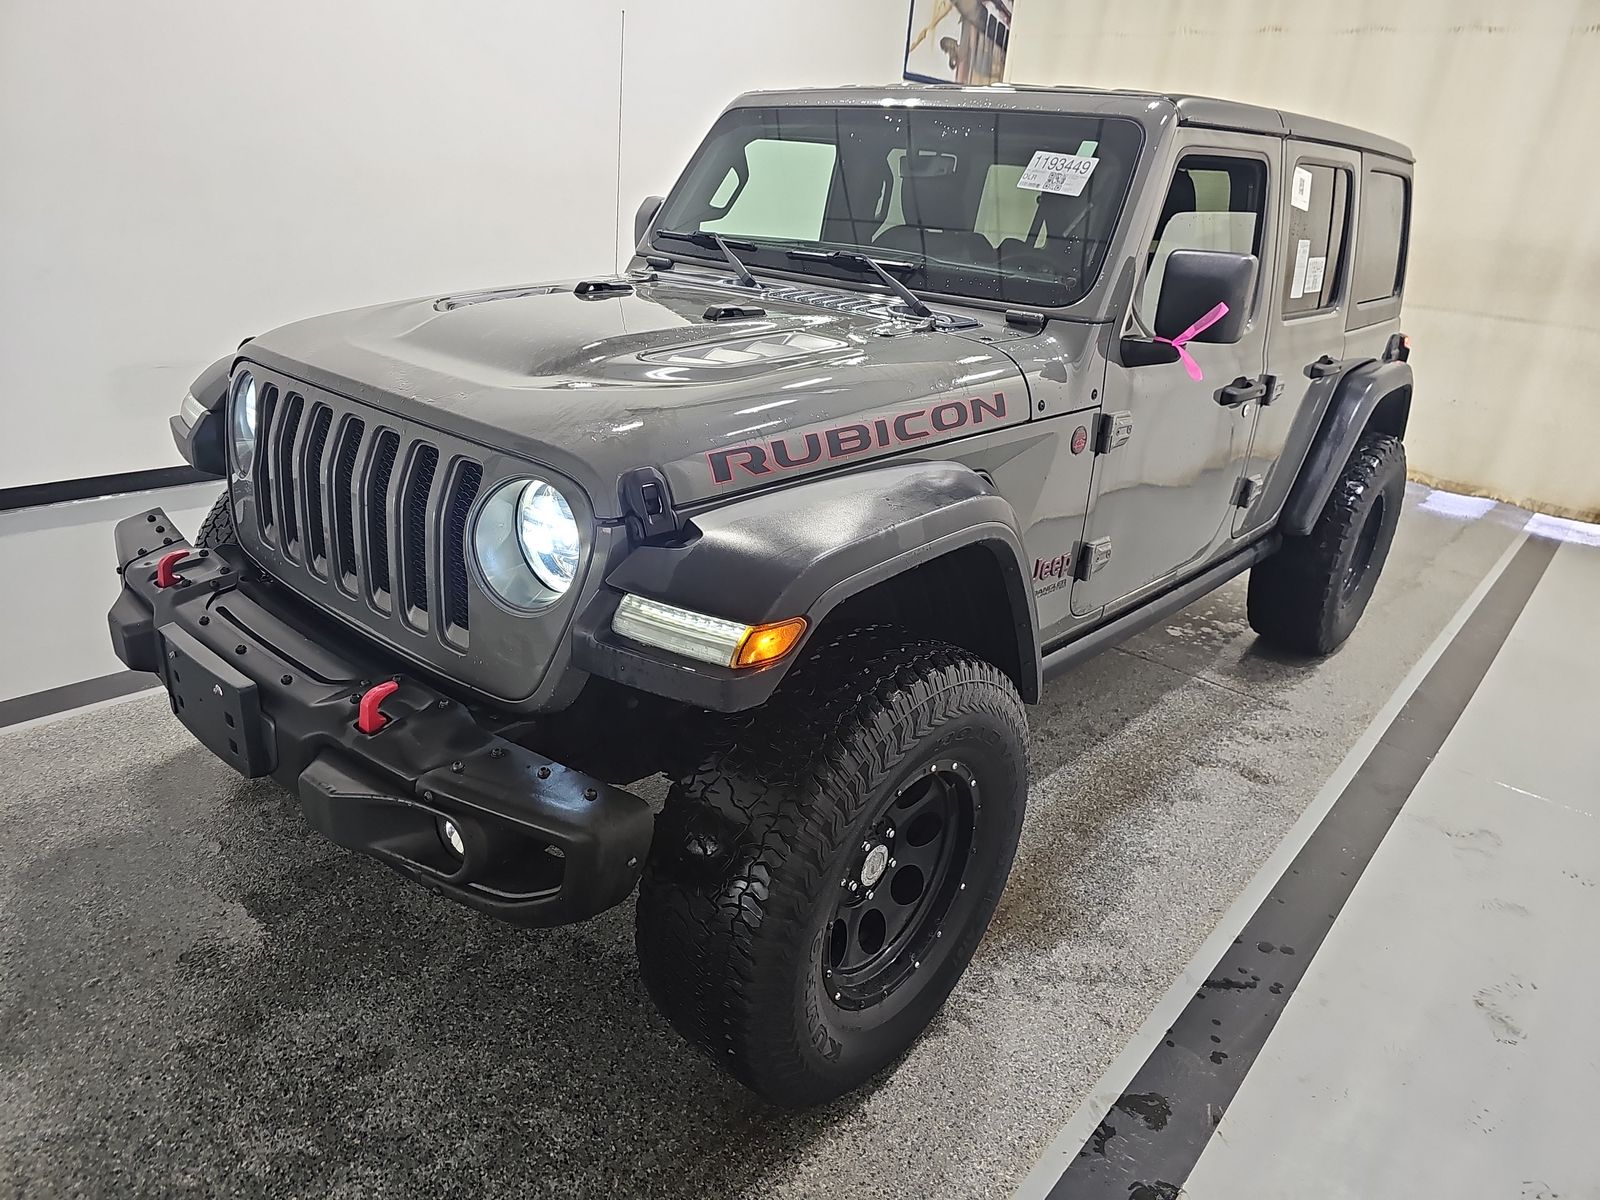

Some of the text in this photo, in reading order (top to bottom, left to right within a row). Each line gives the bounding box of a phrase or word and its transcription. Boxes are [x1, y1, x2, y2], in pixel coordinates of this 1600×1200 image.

[1034, 155, 1092, 175] 1193449
[705, 392, 1007, 485] RUBICON
[1031, 552, 1072, 581] Jeep
